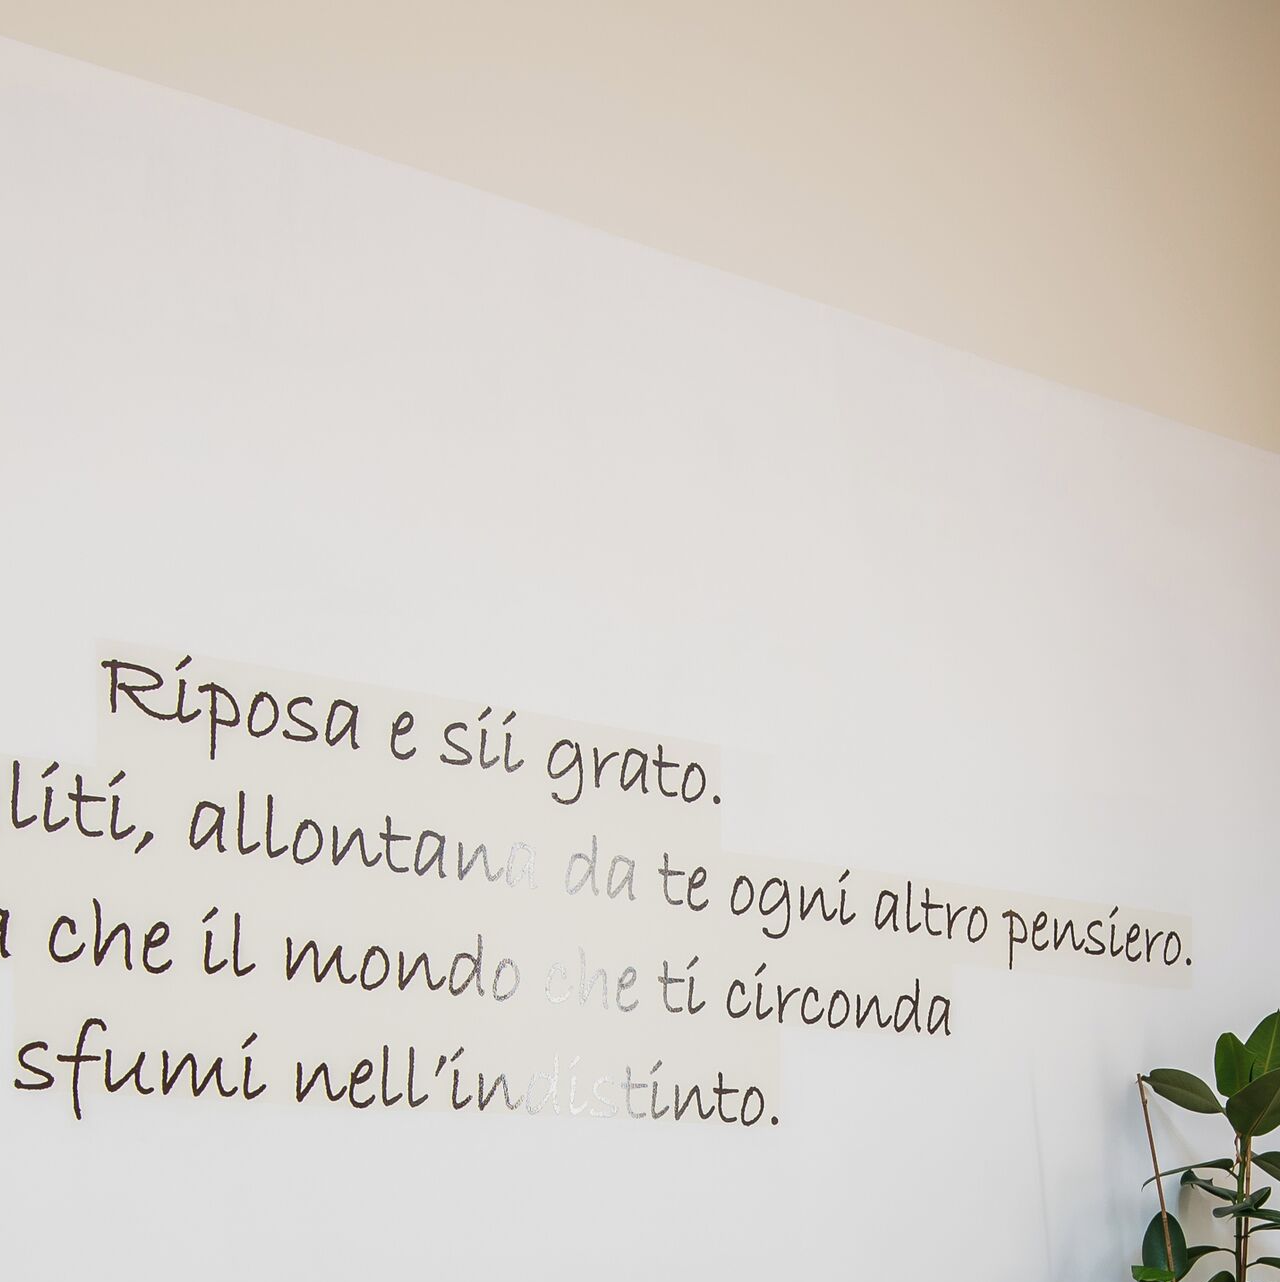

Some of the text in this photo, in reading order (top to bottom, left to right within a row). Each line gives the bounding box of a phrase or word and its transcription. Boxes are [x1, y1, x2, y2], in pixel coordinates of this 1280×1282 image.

[100, 654, 723, 805] Riposa e sii grato.
[188, 790, 539, 890] allontana
[564, 834, 636, 902] da
[657, 851, 710, 912] te
[730, 868, 857, 940] ogni
[874, 880, 989, 944] altro
[1001, 905, 1194, 971] pensiero.
[48, 897, 173, 975] che
[201, 905, 257, 978] il
[285, 933, 521, 1003] mondo
[544, 945, 640, 1013] che
[657, 955, 707, 1016] ti
[726, 961, 953, 1037] circonda
[13, 1017, 780, 1128] sfumi nell'indistinto.
